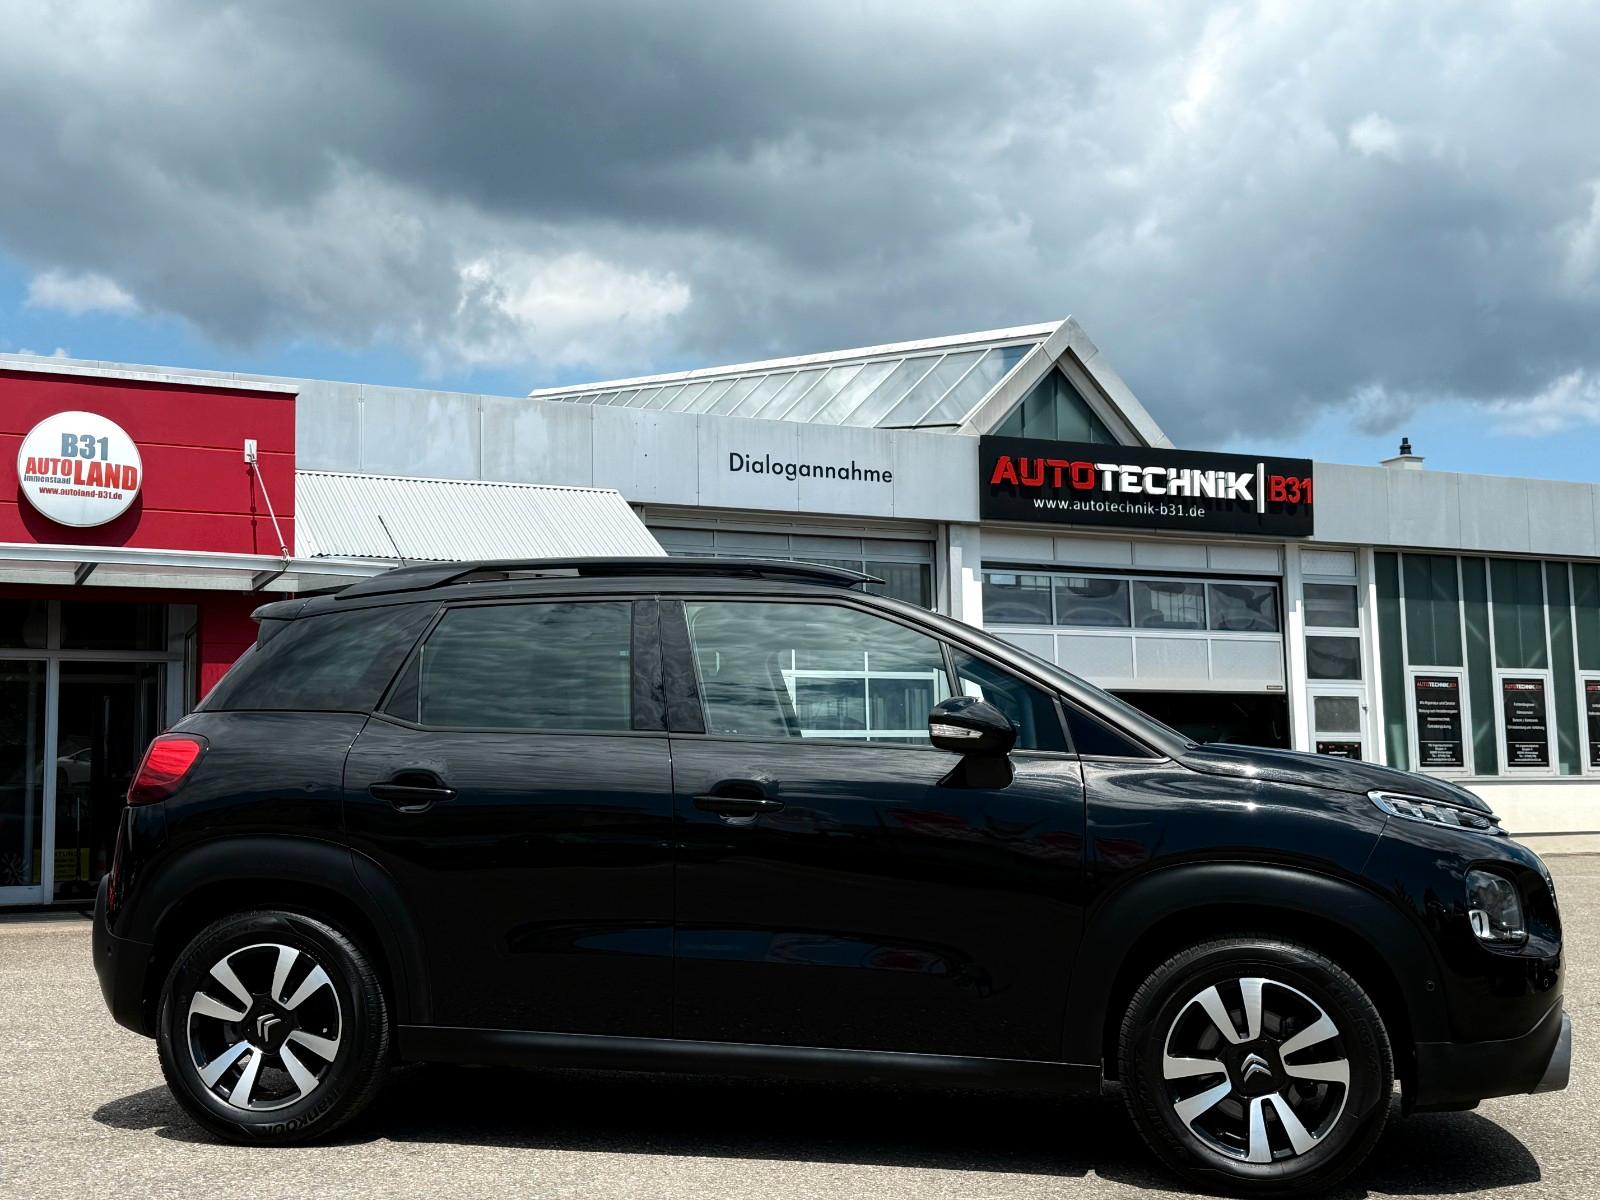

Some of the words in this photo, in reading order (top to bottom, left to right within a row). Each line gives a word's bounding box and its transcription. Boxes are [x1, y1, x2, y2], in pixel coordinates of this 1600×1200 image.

[61, 433, 109, 461] B31
[24, 474, 71, 485] Immenstaad
[729, 452, 893, 483] Dialogannahme
[1267, 475, 1313, 505] B31
[1033, 498, 1206, 518] www.autotechnik-b31.de
